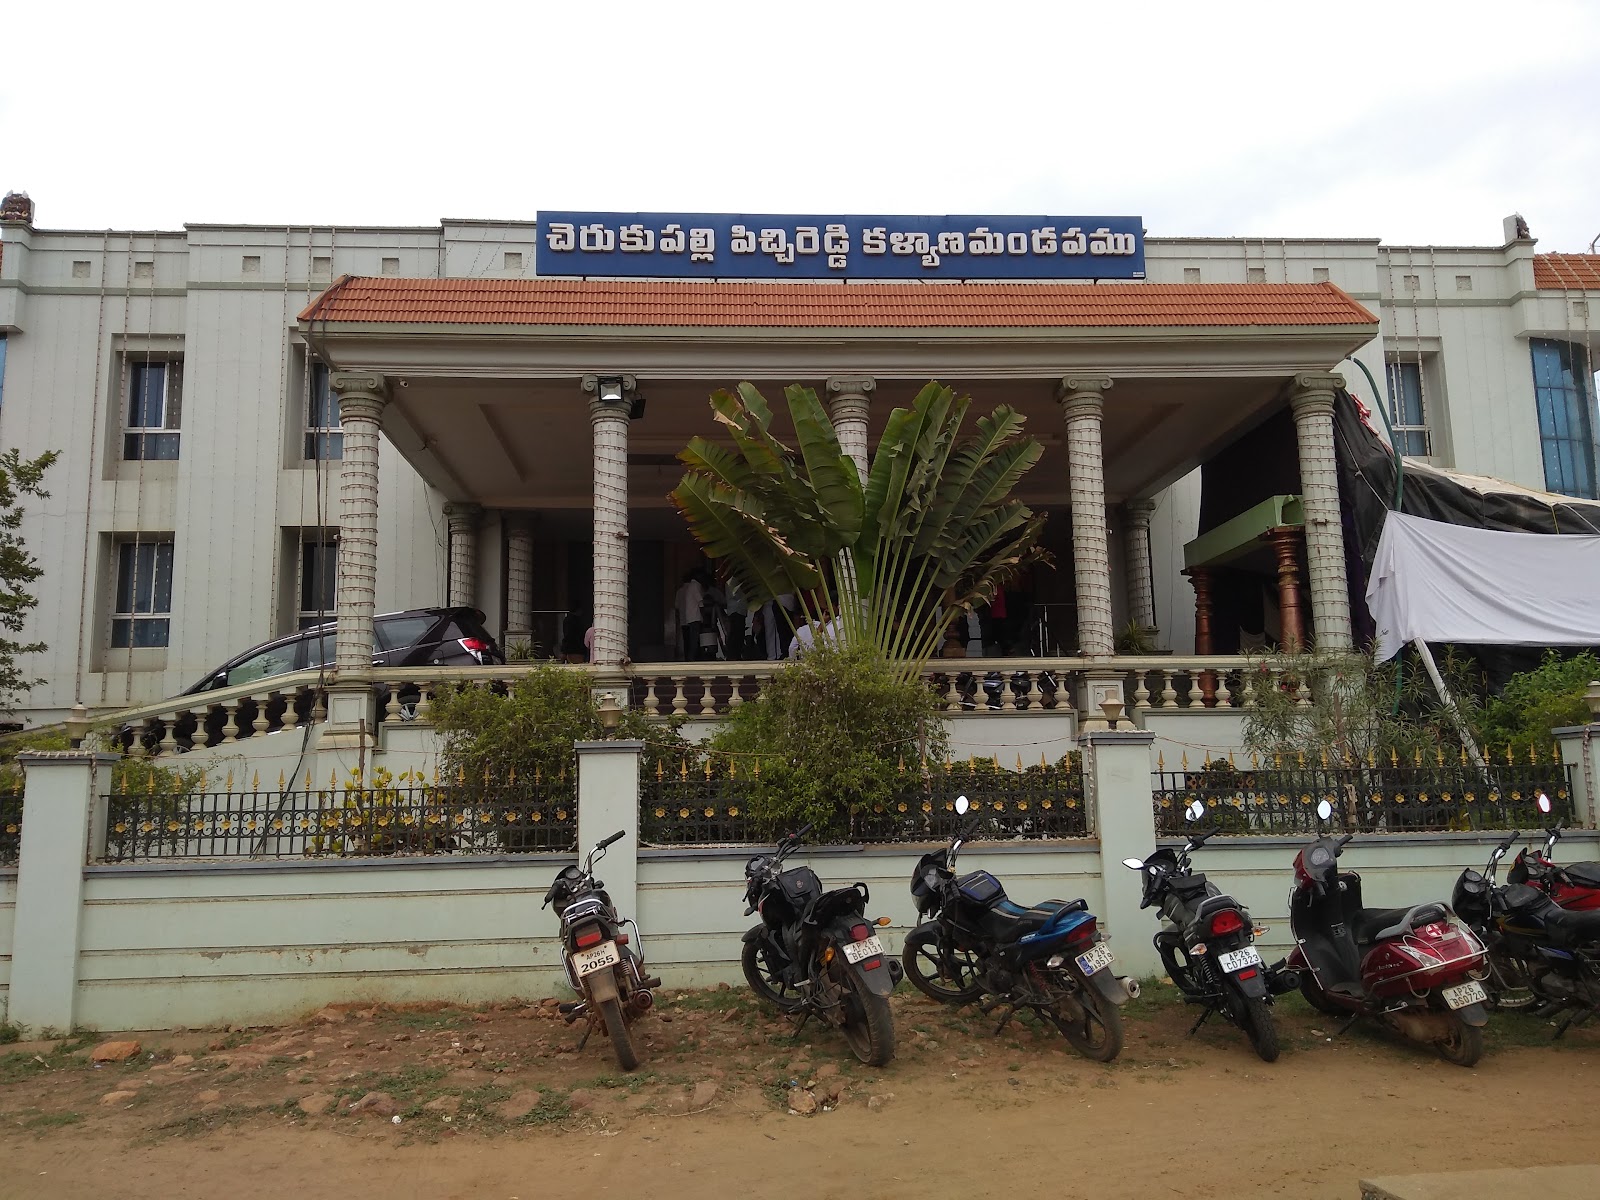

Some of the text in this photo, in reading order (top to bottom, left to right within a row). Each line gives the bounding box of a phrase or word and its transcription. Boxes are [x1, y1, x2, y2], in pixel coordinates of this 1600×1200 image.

[546, 222, 1136, 268] చెరుకుపల్లి పిచ్చిరెడ్డి కళ్యాణమండపము
[851, 943, 883, 961] BE0131
[580, 954, 614, 973] 2055
[1226, 954, 1260, 970] CD7323
[1453, 990, 1485, 1007] BS0720
